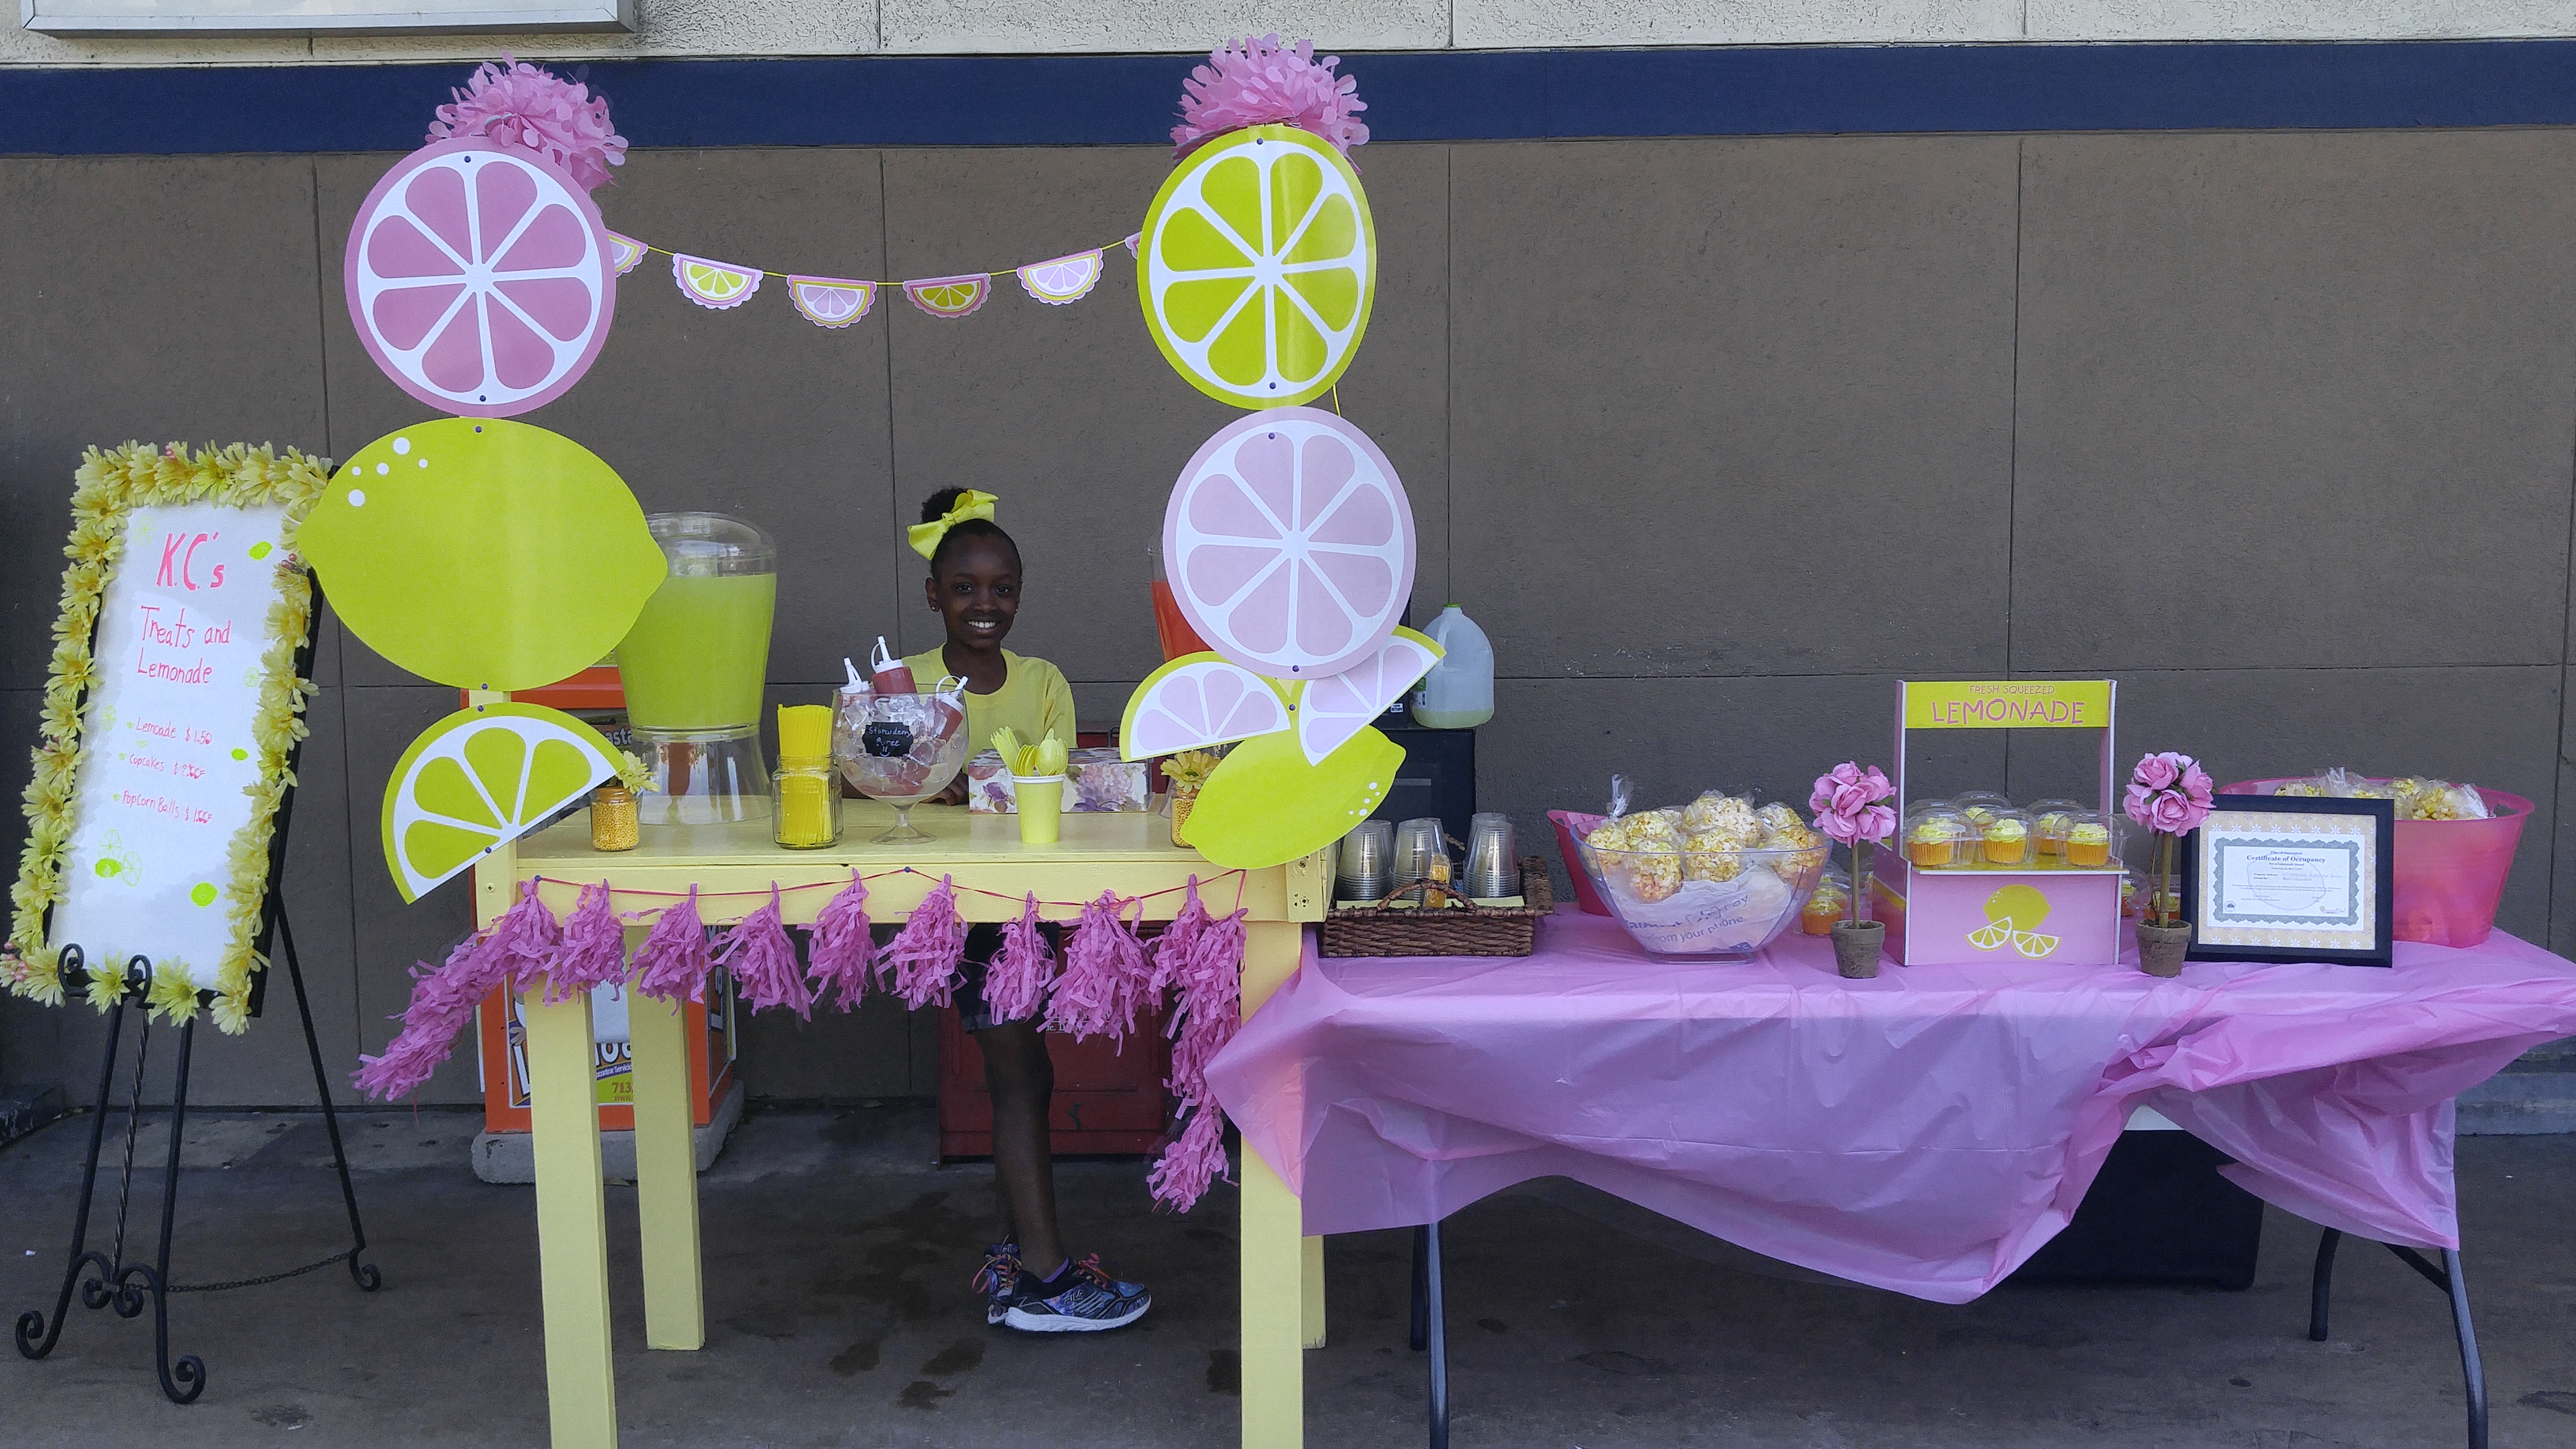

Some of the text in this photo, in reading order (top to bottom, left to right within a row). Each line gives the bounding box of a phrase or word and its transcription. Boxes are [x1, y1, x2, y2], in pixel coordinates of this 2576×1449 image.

[140, 604, 231, 648] Treats and
[137, 646, 212, 684] Lemonade
[1969, 684, 2055, 694] FRESH SQUEEZED
[1932, 698, 2085, 725] LEMONADE
[2290, 855, 2326, 864] Occupancy
[1681, 929, 1705, 943] your
[1063, 1288, 1084, 1305] FILA
